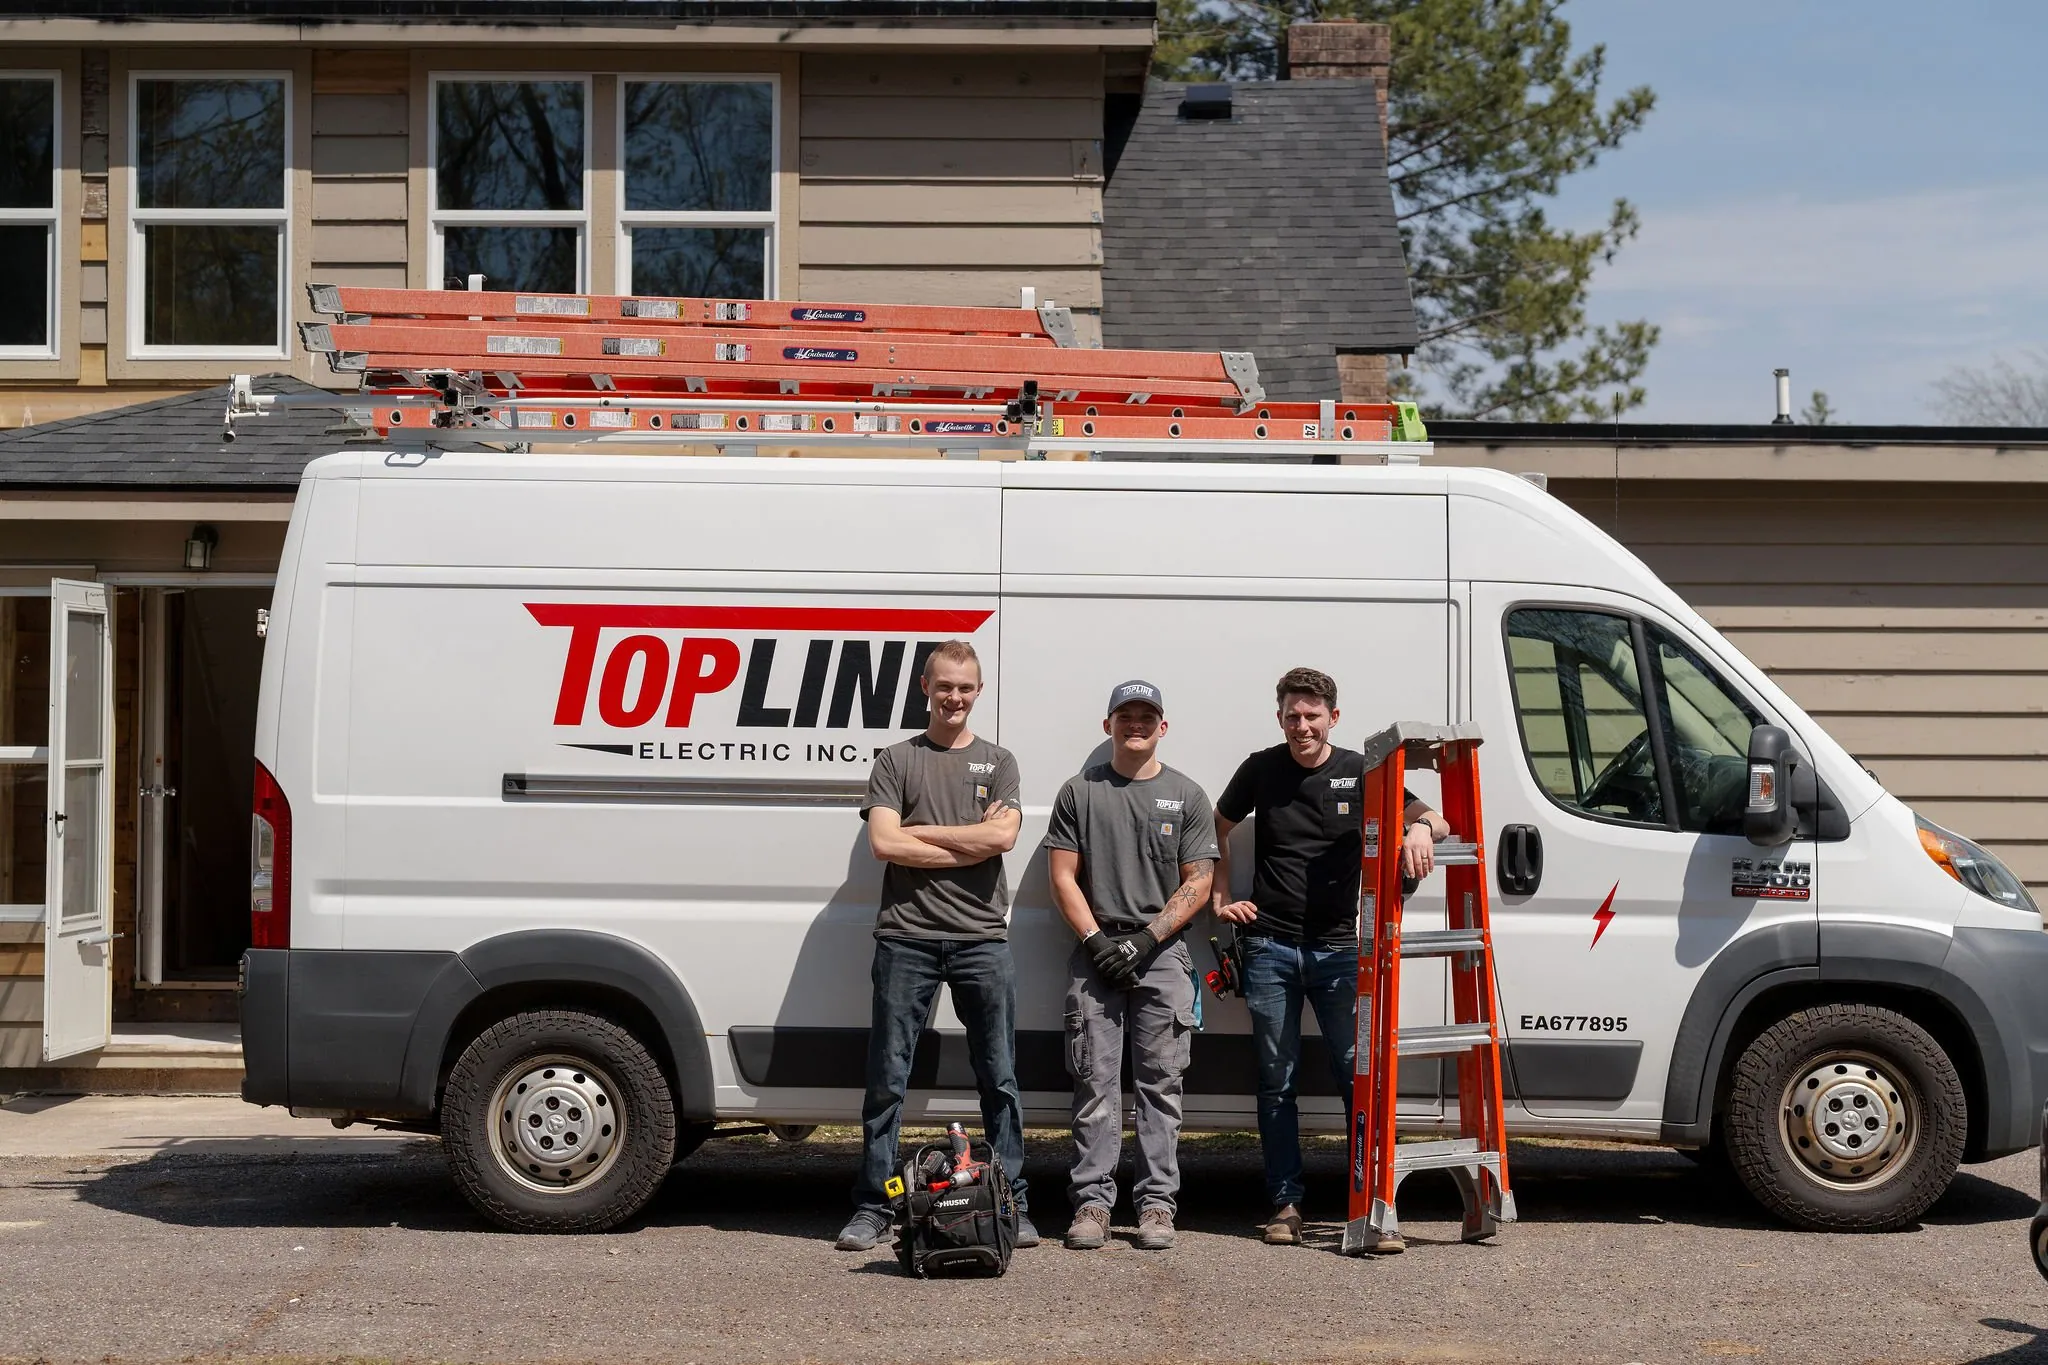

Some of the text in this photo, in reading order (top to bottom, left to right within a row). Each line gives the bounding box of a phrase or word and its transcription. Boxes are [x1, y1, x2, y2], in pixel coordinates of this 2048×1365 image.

[1121, 684, 1153, 697] TOPLINE
[639, 742, 869, 763] ELECTRIC INC.
[968, 762, 996, 773] TOPLE
[1330, 777, 1357, 788] TOPLINE
[1155, 798, 1184, 810] TOPLINE
[1520, 1015, 1628, 1032] EA677895
[943, 1198, 969, 1207] HUSKY
